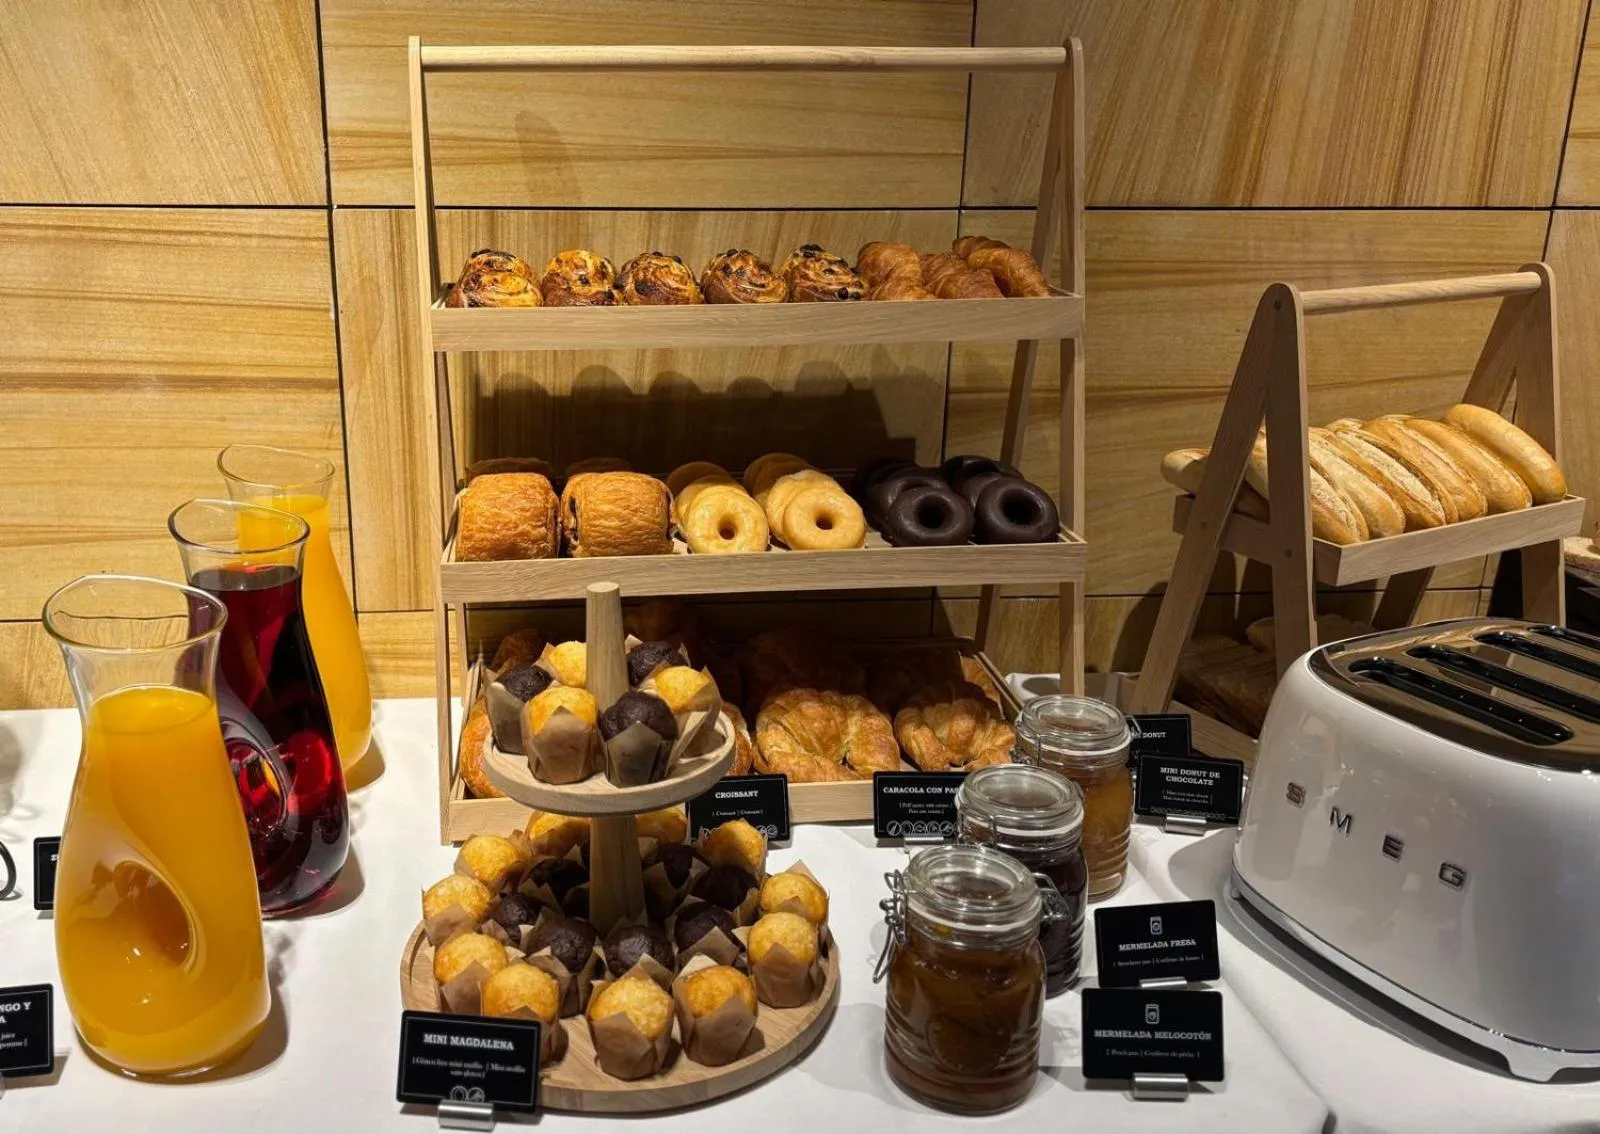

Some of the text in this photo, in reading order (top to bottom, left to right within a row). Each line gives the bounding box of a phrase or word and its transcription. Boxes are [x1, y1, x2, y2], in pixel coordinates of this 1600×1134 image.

[1160, 767, 1221, 779] MINI DONUT DE
[1165, 775, 1214, 786] CHOCOLATE
[715, 790, 759, 799] CROISSANT
[883, 786, 925, 794] CARACOLA
[926, 786, 943, 794] CON
[1286, 781, 1468, 892] SMEG
[1118, 938, 1197, 952] MERMELADA FRESA
[23, 1001, 32, 1010] Y
[1094, 1029, 1213, 1041] MERMELADA MELOCOTÓN
[423, 1033, 515, 1051] MINI MAGDALENA
